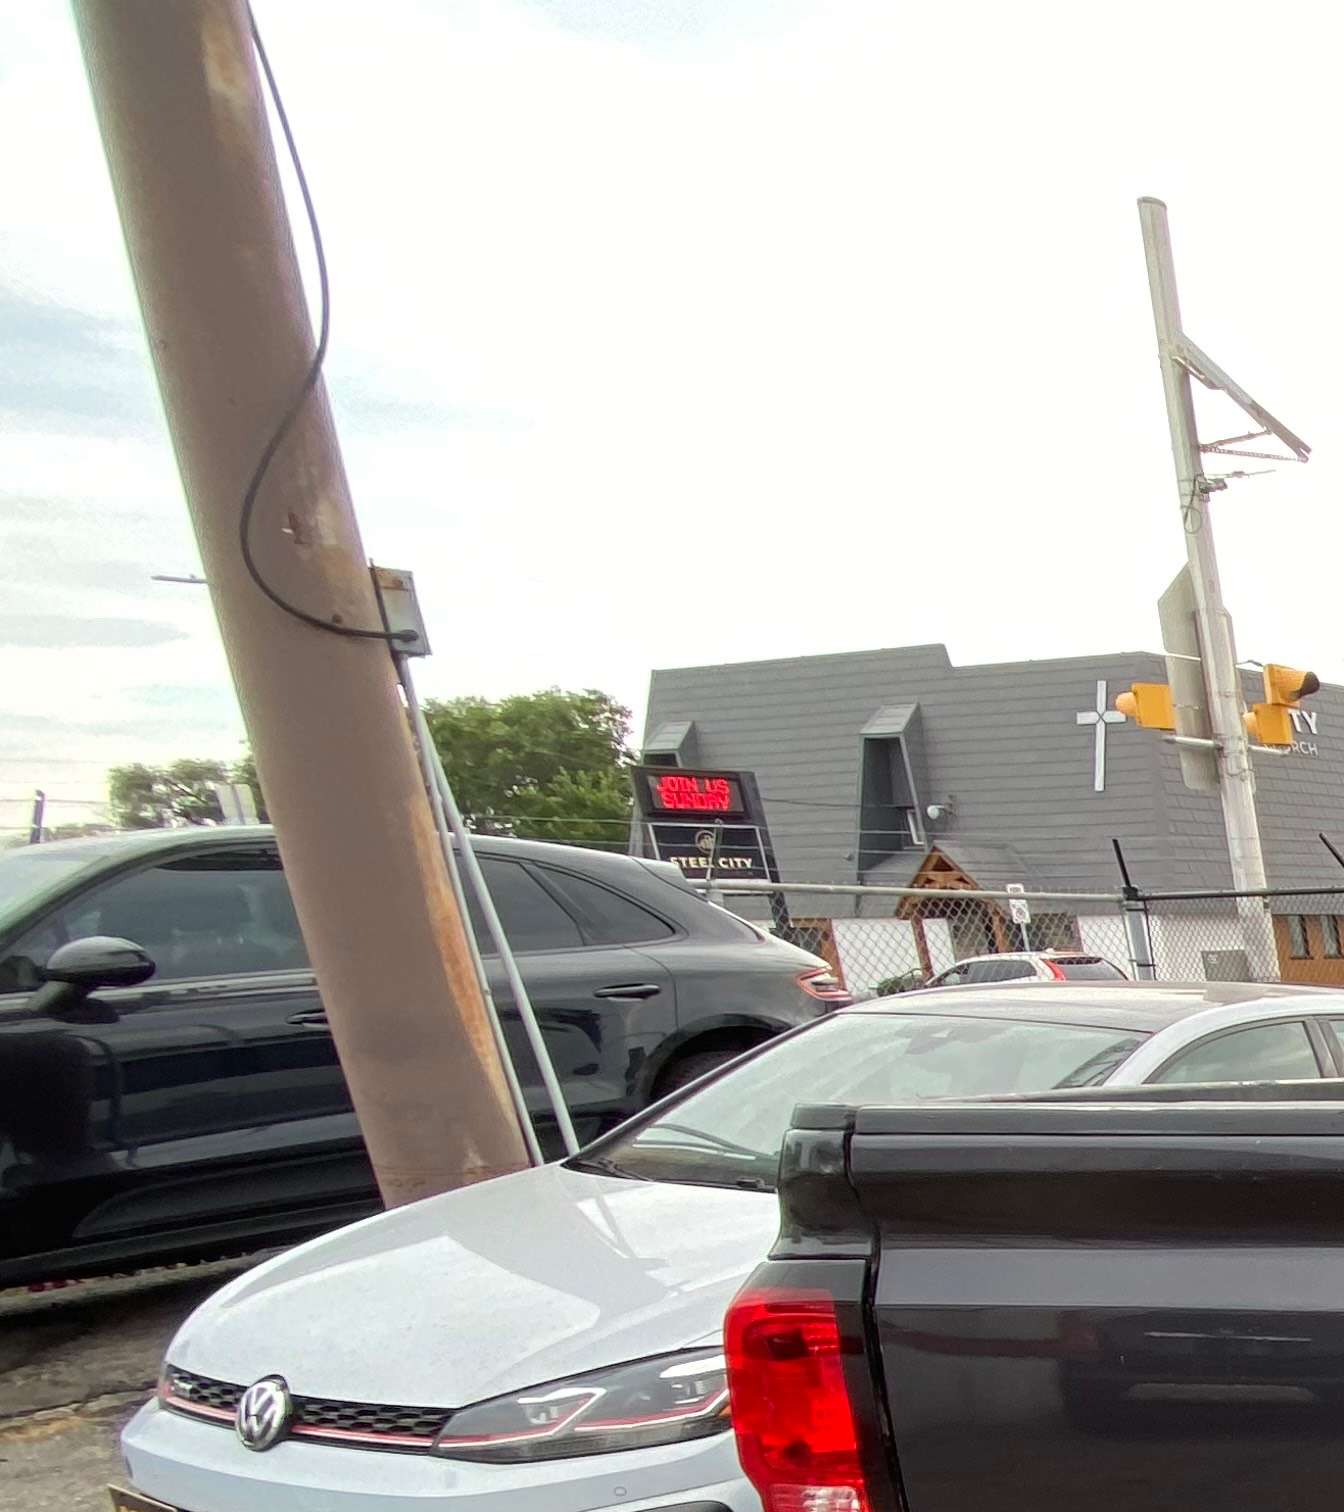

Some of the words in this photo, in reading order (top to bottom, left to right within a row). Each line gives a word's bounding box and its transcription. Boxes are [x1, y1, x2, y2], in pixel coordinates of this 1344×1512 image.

[1287, 708, 1318, 735] TY
[656, 775, 698, 793] JOIN
[705, 778, 730, 794] US
[661, 792, 730, 812] SUNDAY
[718, 857, 753, 869] CITY
